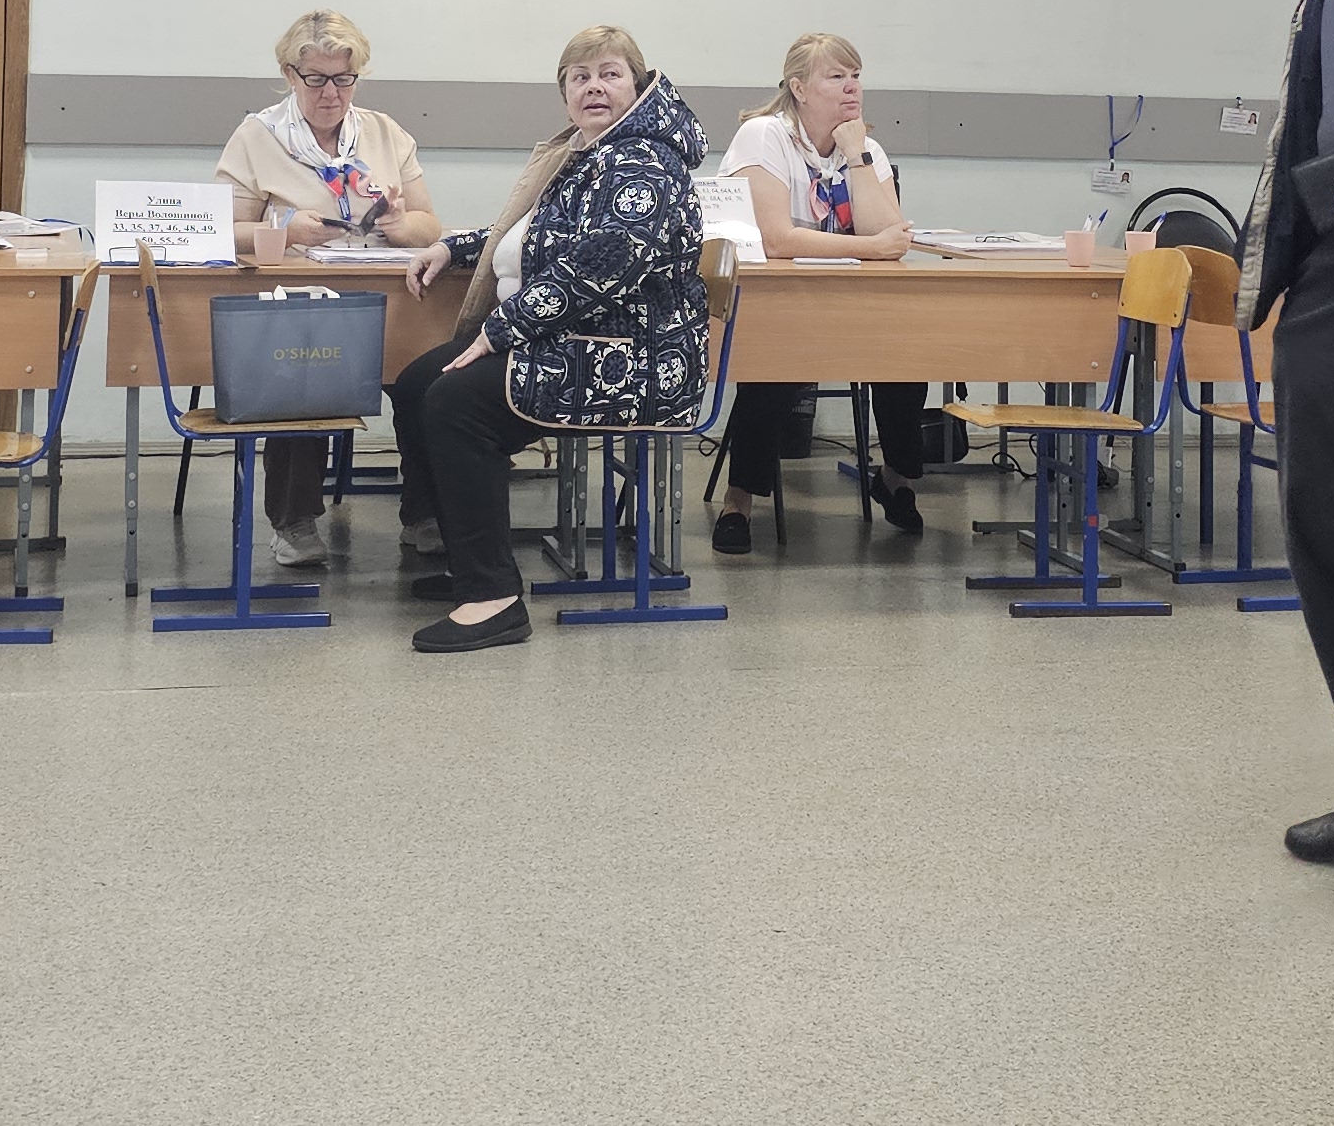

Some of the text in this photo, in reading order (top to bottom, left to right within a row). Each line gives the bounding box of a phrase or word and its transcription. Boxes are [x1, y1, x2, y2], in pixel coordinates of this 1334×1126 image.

[147, 196, 182, 206] Улица
[115, 209, 144, 219] Веры
[113, 223, 216, 234] 33, 35, 37, 46, 48, 49,
[159, 237, 174, 245] 55,
[273, 347, 342, 361] O'SHADE
